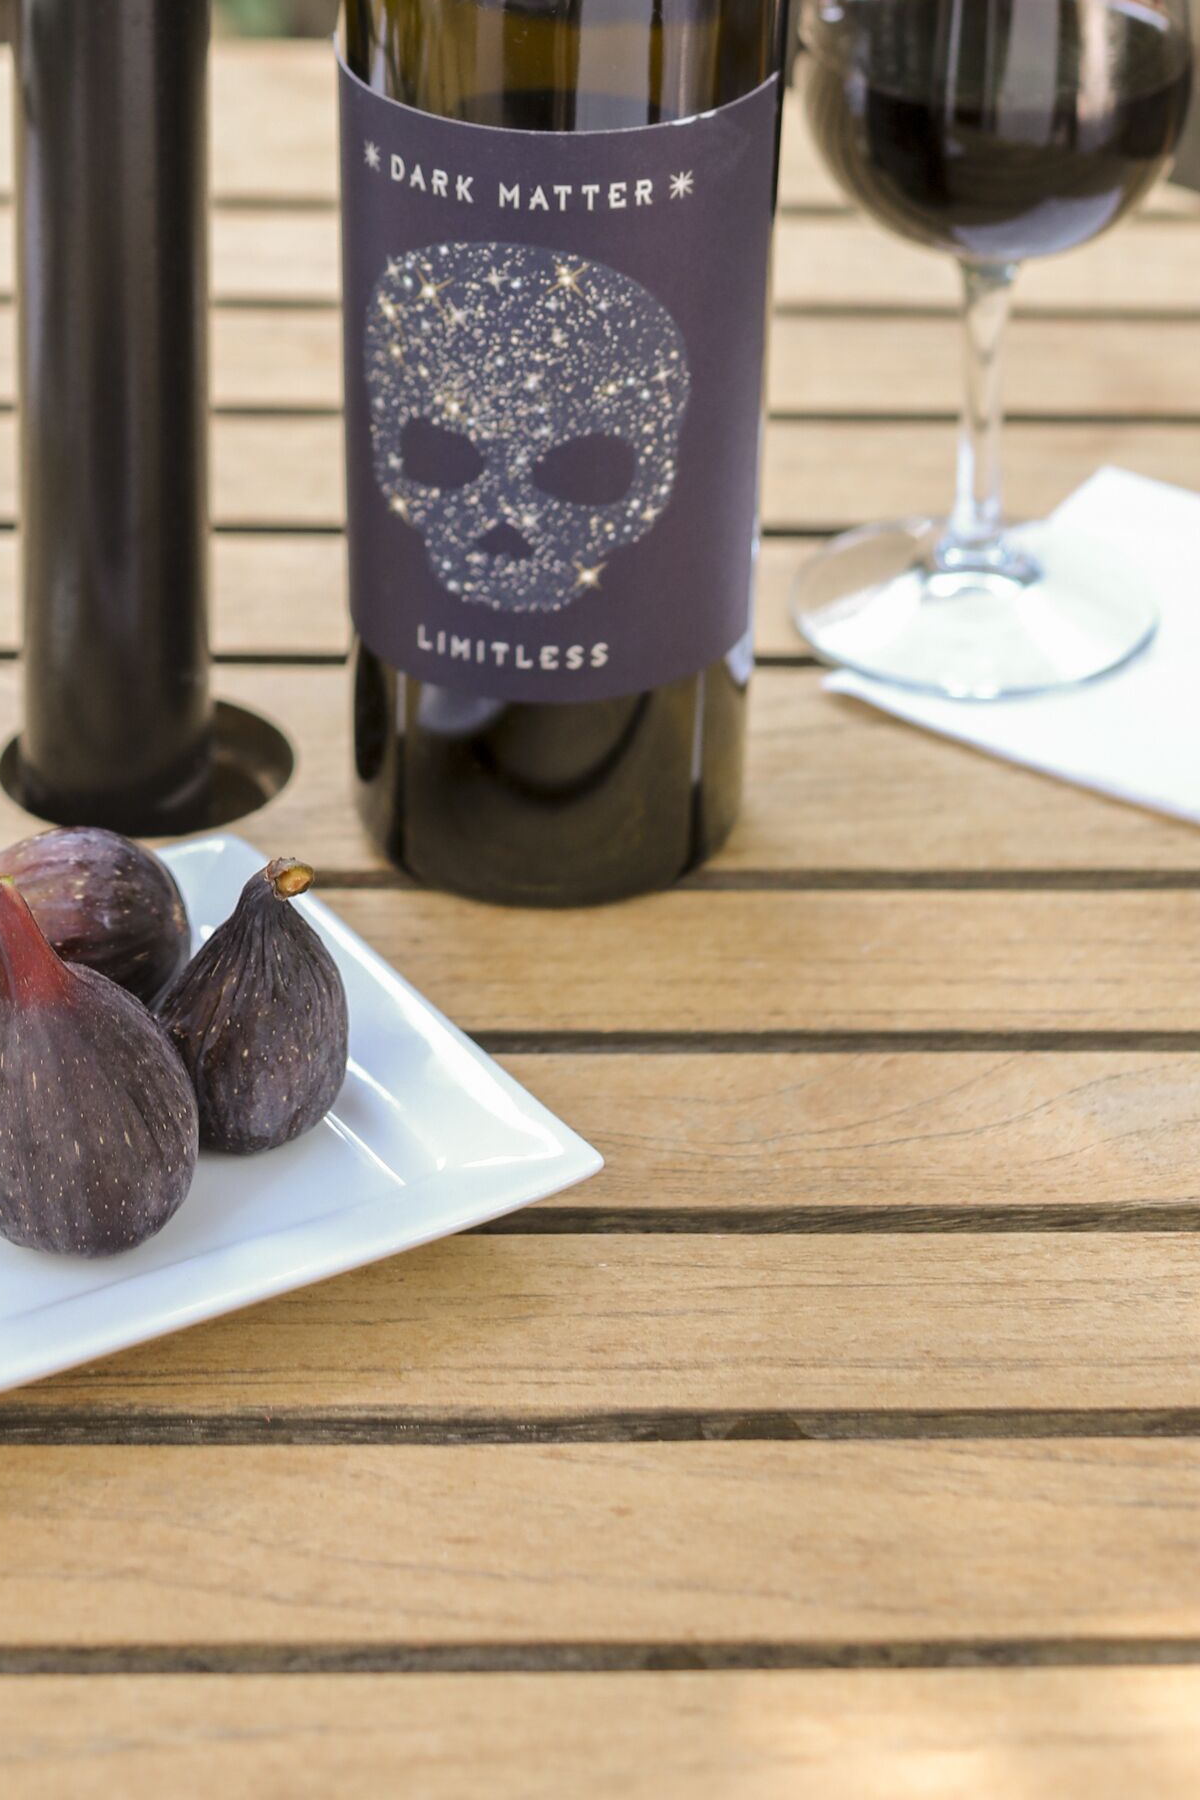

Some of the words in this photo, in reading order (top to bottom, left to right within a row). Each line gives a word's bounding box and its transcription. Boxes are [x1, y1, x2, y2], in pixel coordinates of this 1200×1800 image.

[390, 153, 474, 204] DARK
[498, 178, 654, 211] MATTER
[417, 624, 610, 670] LIMITLESS
